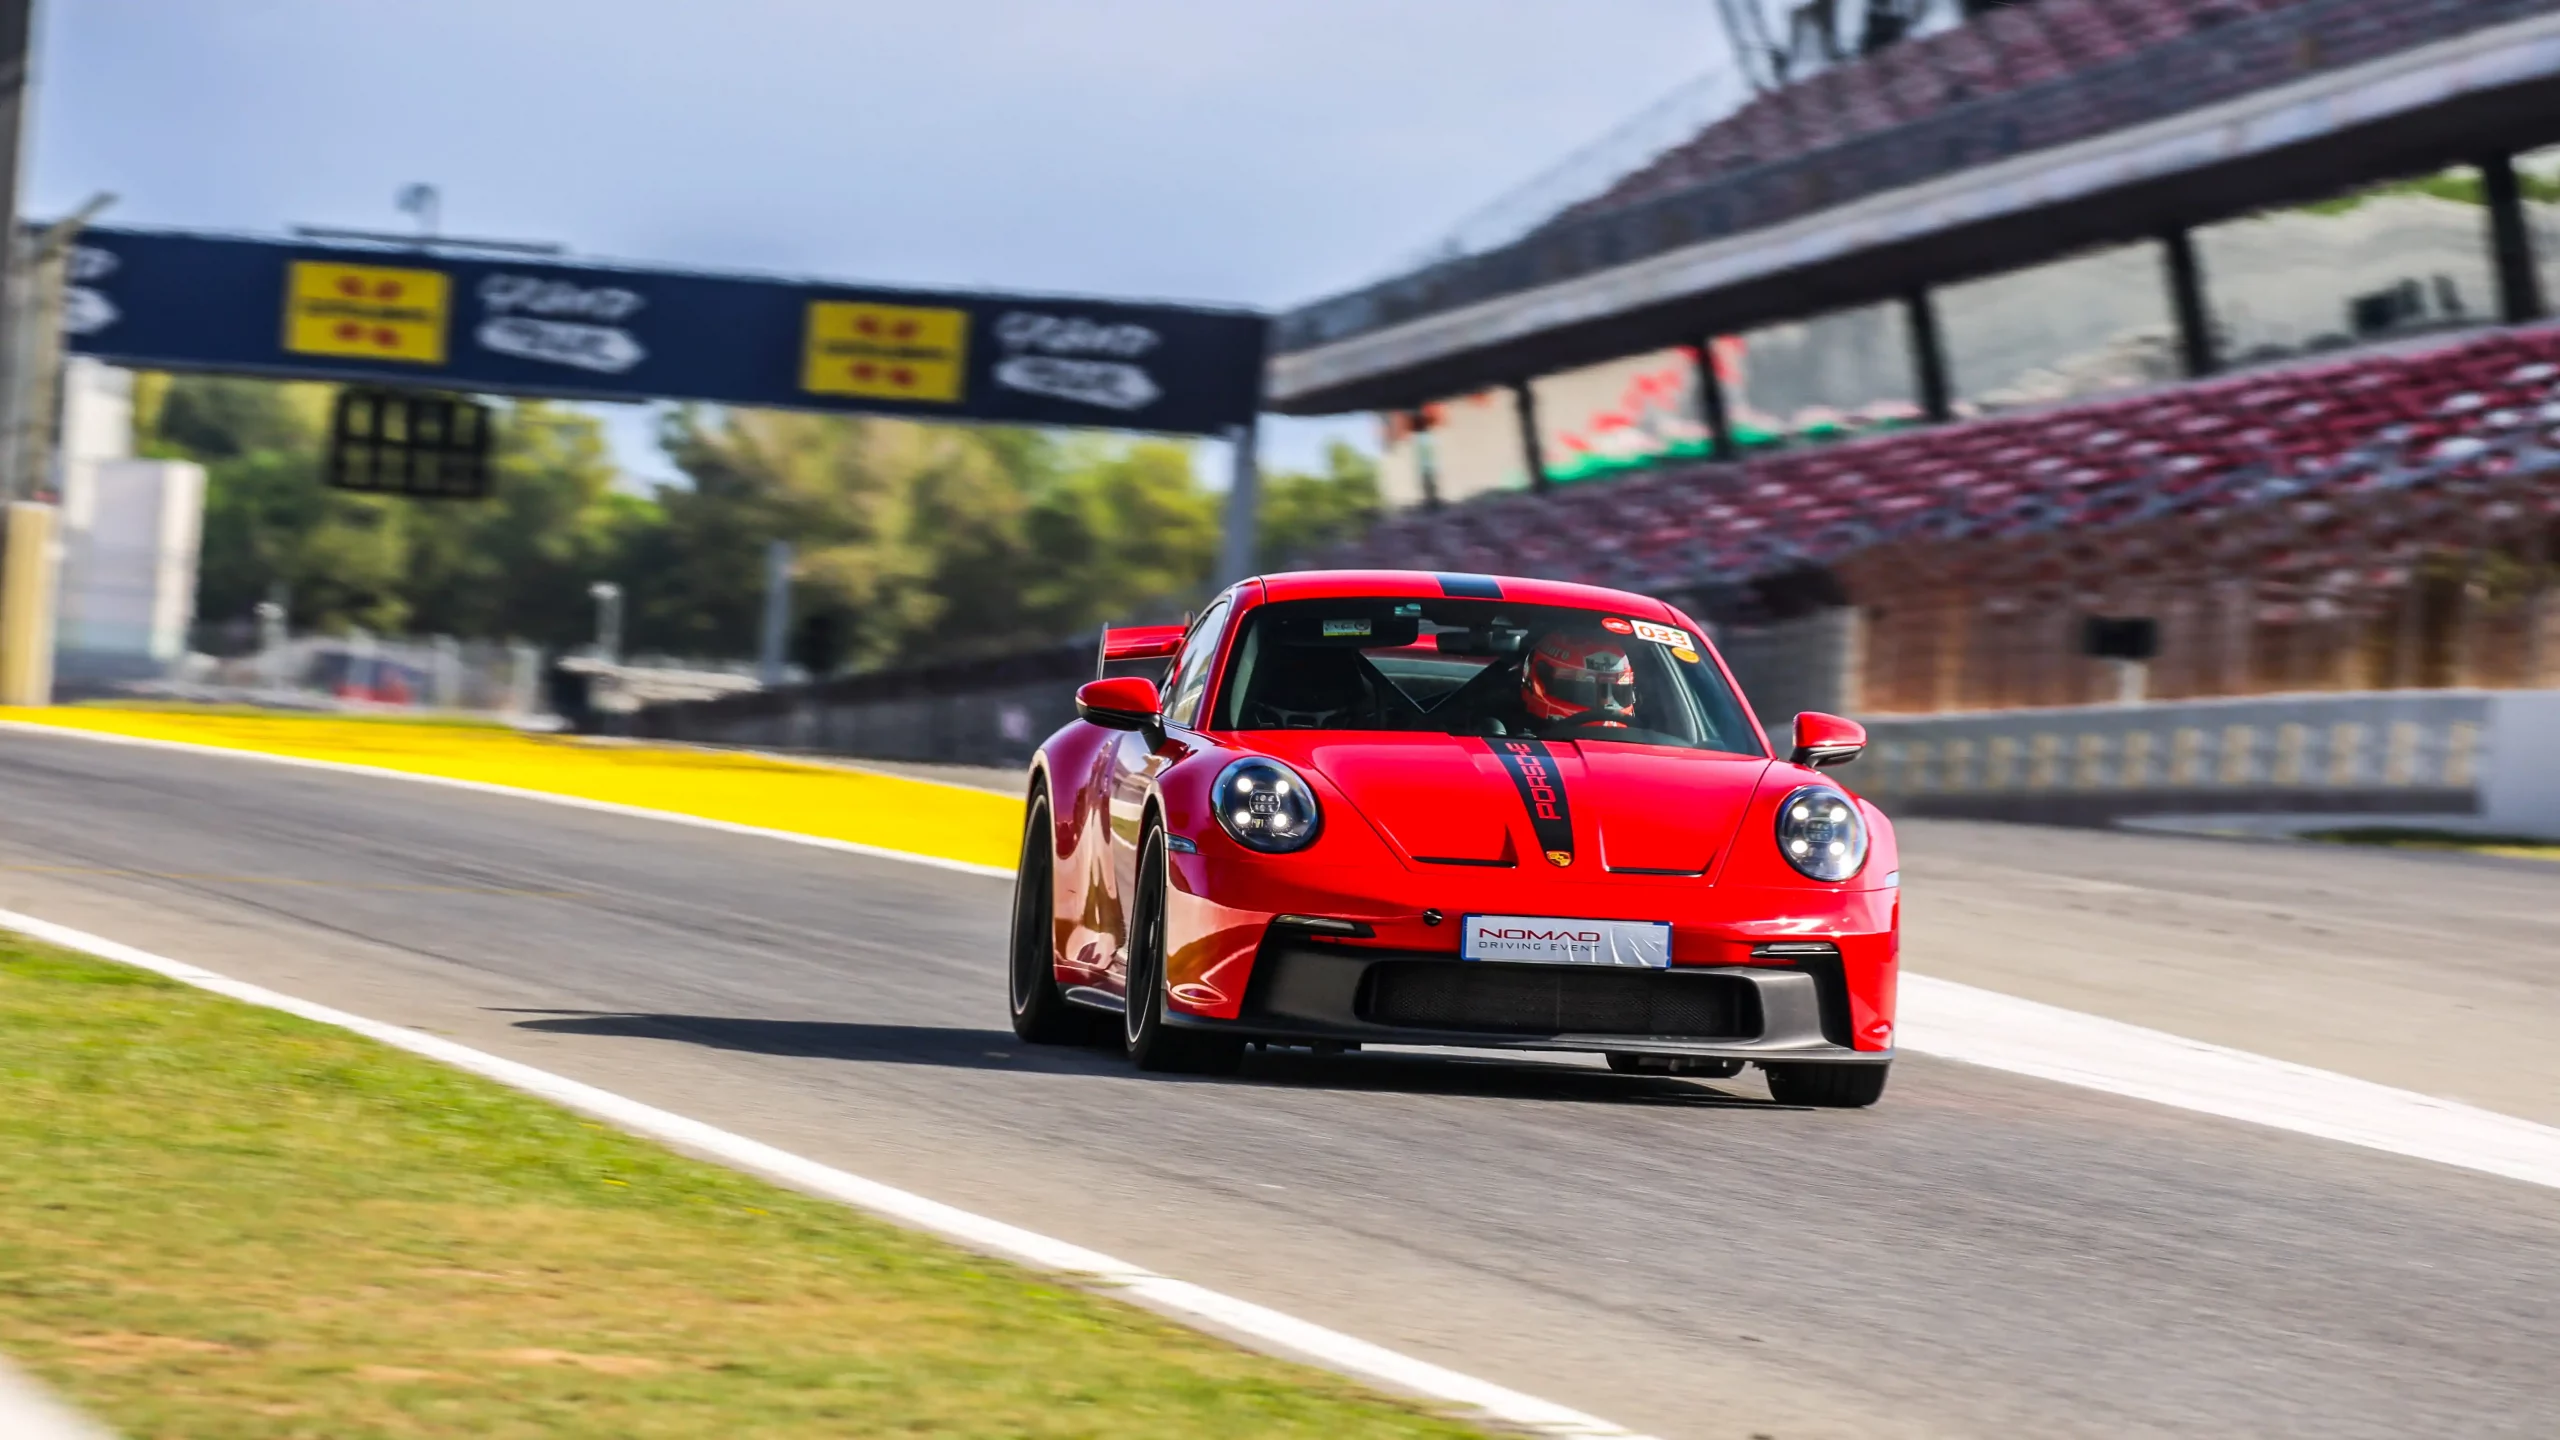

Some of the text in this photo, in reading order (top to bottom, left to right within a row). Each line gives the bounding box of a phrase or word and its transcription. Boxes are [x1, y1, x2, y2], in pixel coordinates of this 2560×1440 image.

[1638, 625, 1688, 646] 033
[1505, 742, 1562, 820] PORSCHE
[1479, 928, 1600, 942] NOMAD
[1478, 941, 1600, 953] DRIVING EVENT
